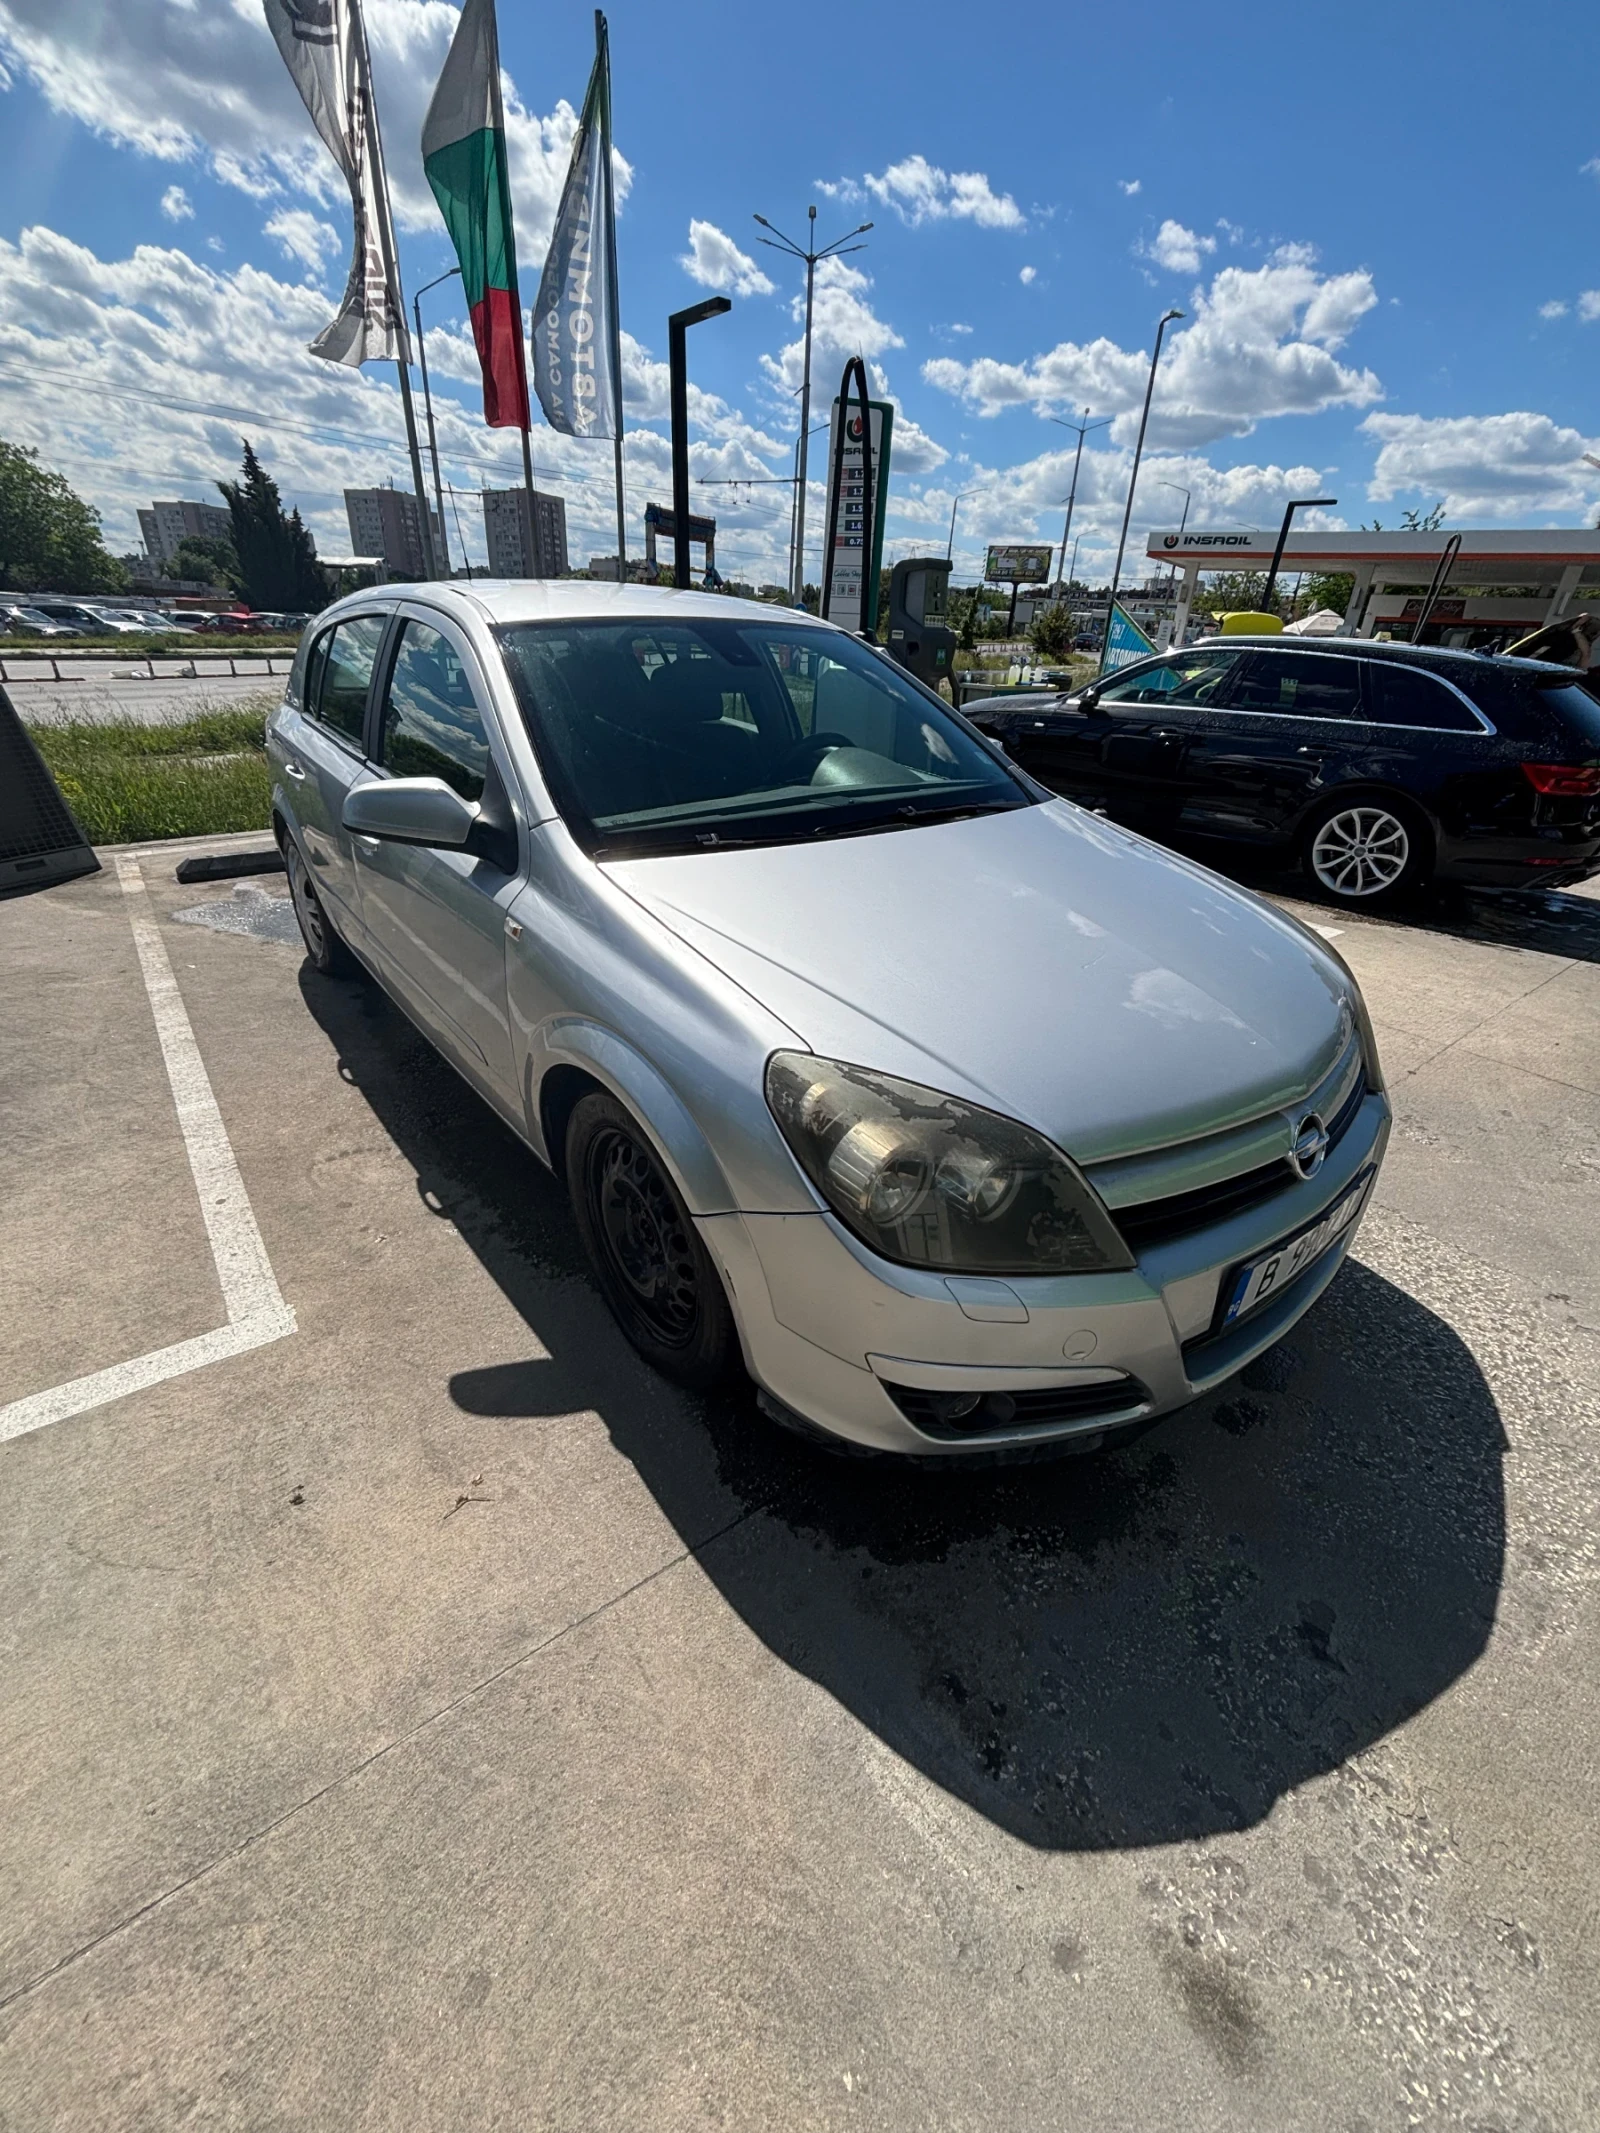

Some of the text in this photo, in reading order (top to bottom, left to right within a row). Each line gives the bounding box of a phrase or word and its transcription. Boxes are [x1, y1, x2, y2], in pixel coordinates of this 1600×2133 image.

[1183, 536, 1252, 545] INSAOIL
[1442, 601, 1462, 615] Shop
[1254, 1257, 1280, 1299] B
[1228, 1300, 1241, 1315] BG
